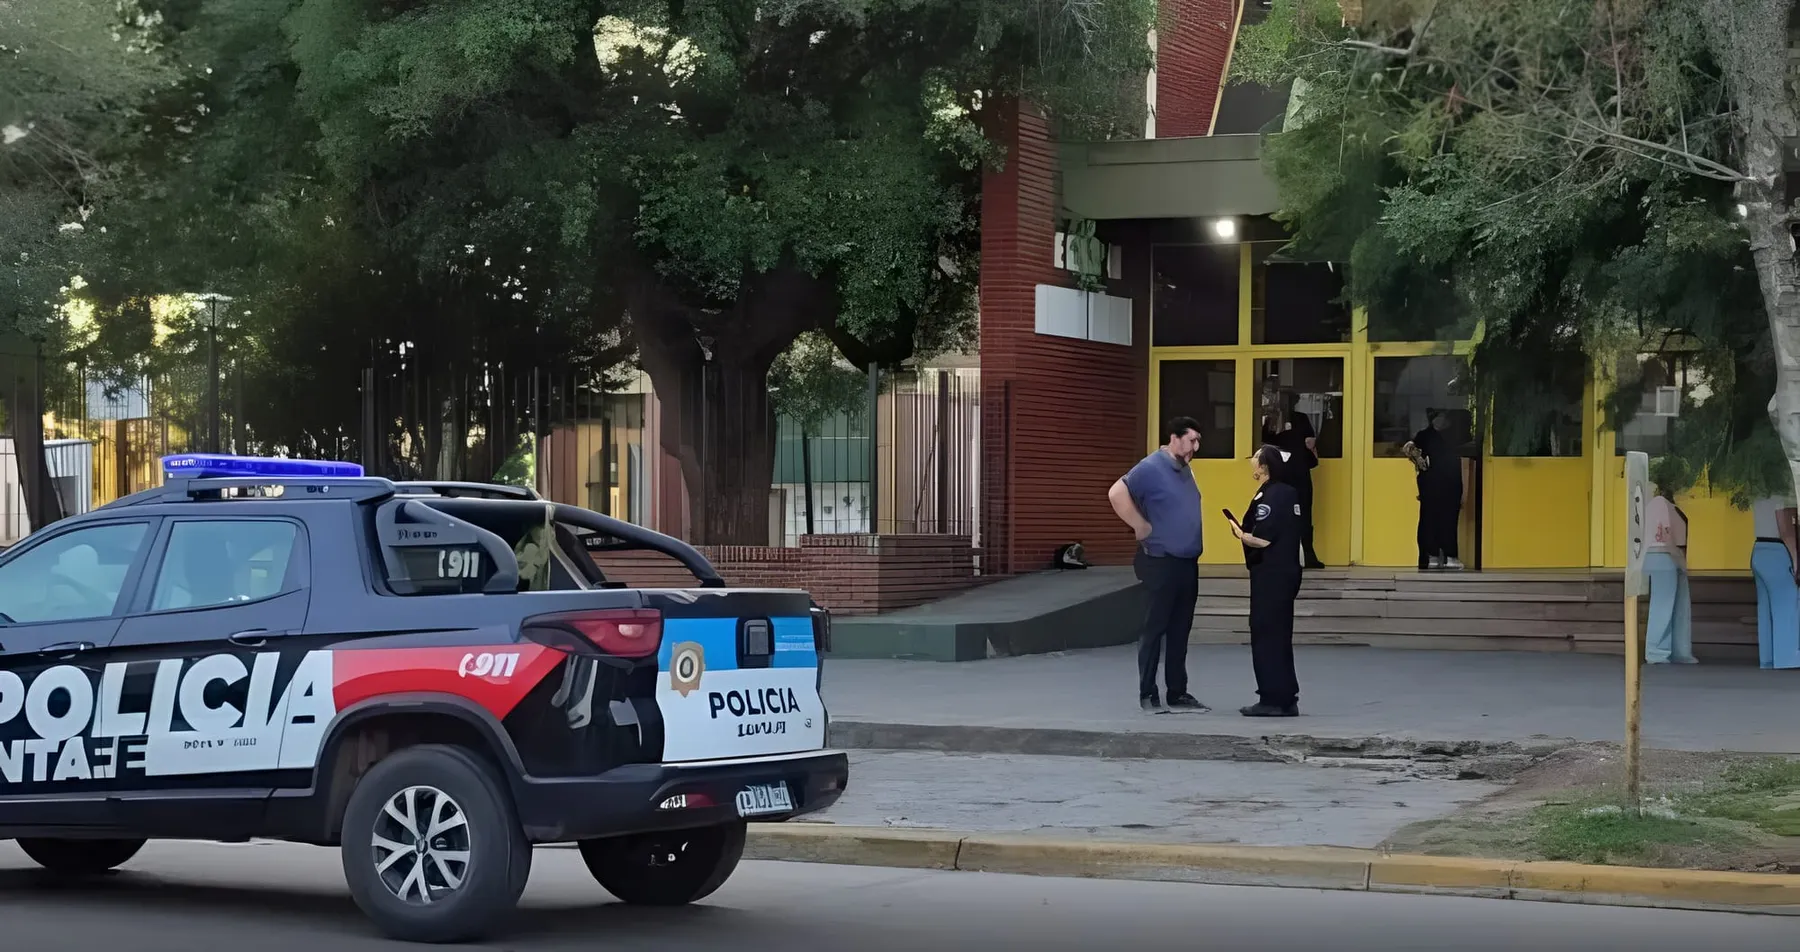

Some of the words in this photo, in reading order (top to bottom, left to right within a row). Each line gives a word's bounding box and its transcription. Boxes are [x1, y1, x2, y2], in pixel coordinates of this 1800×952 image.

[448, 551, 480, 578] 911
[475, 653, 520, 677] 911
[708, 687, 801, 719] POLICIA
